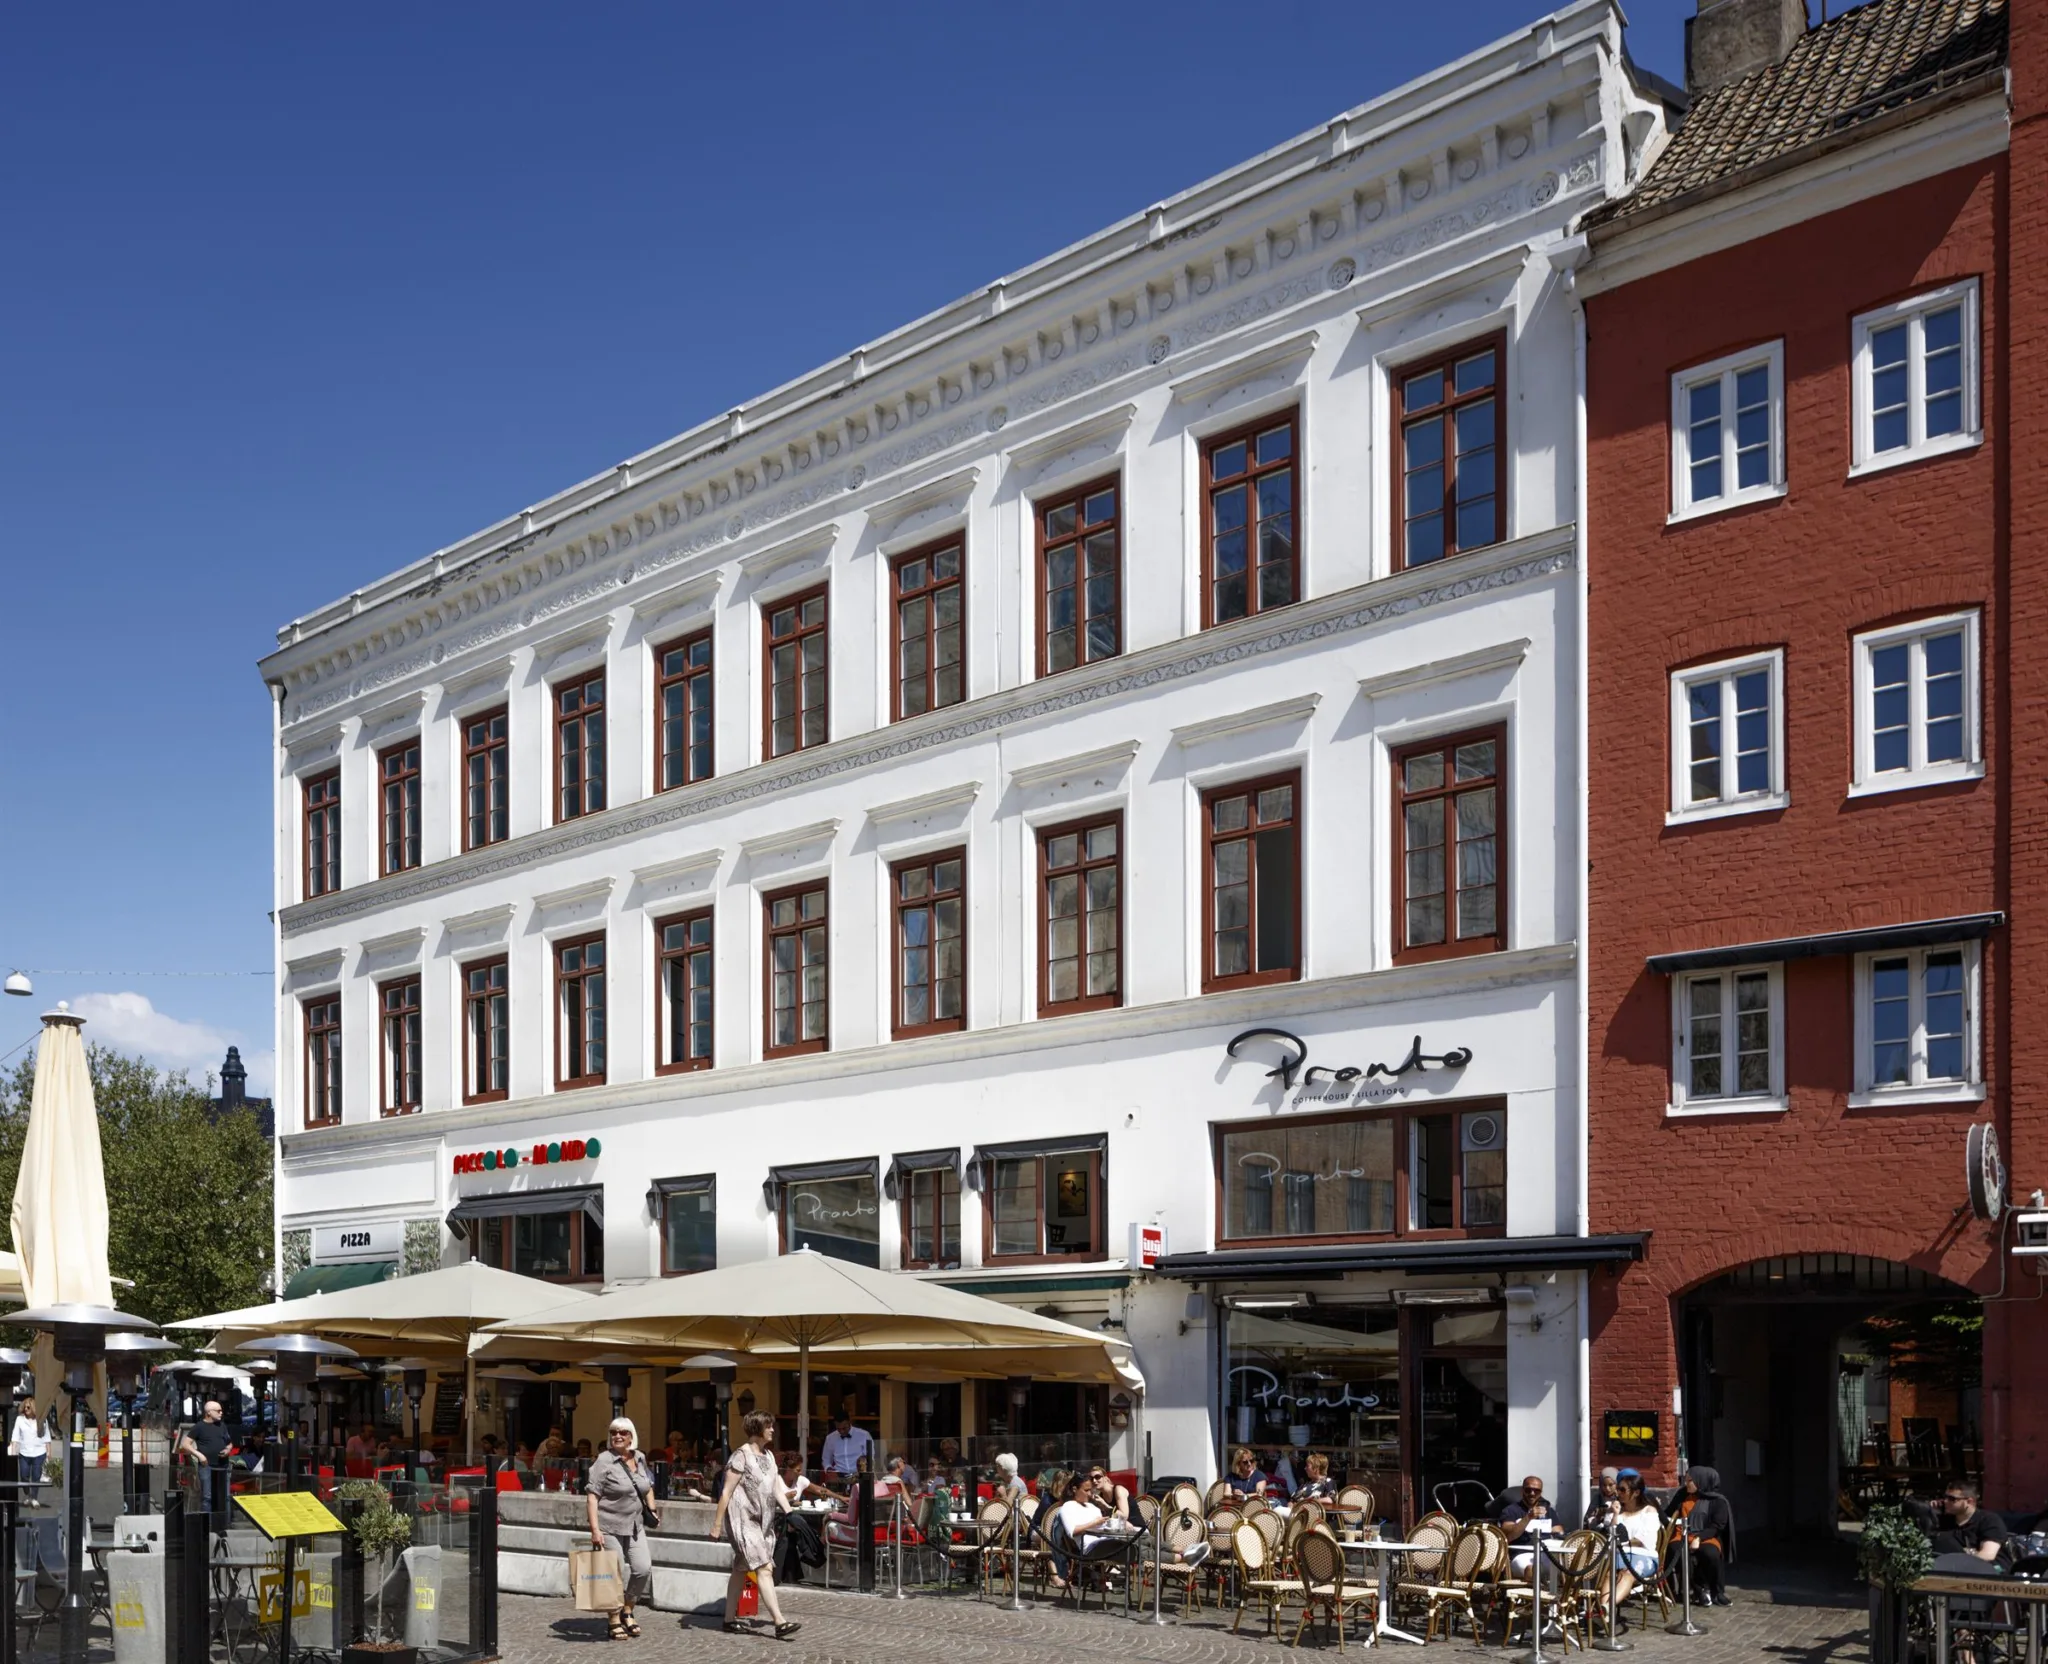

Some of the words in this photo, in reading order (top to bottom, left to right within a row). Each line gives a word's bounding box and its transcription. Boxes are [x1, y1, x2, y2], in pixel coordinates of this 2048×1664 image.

[1227, 1028, 1473, 1090] Pronto
[1292, 1091, 1349, 1105] COFFEEHOUSE
[1357, 1088, 1380, 1098] LILLA
[1382, 1087, 1405, 1096] TORG
[453, 1147, 518, 1175] PICCOLO
[532, 1137, 602, 1166] MONDO
[1238, 1152, 1365, 1185] Pronto
[792, 1192, 878, 1221] Pronto
[340, 1231, 371, 1248] PIZZA
[1227, 1365, 1380, 1408] Pronto
[1609, 1426, 1654, 1439] KIND
[1965, 1582, 2021, 1594] ESPRESSO
